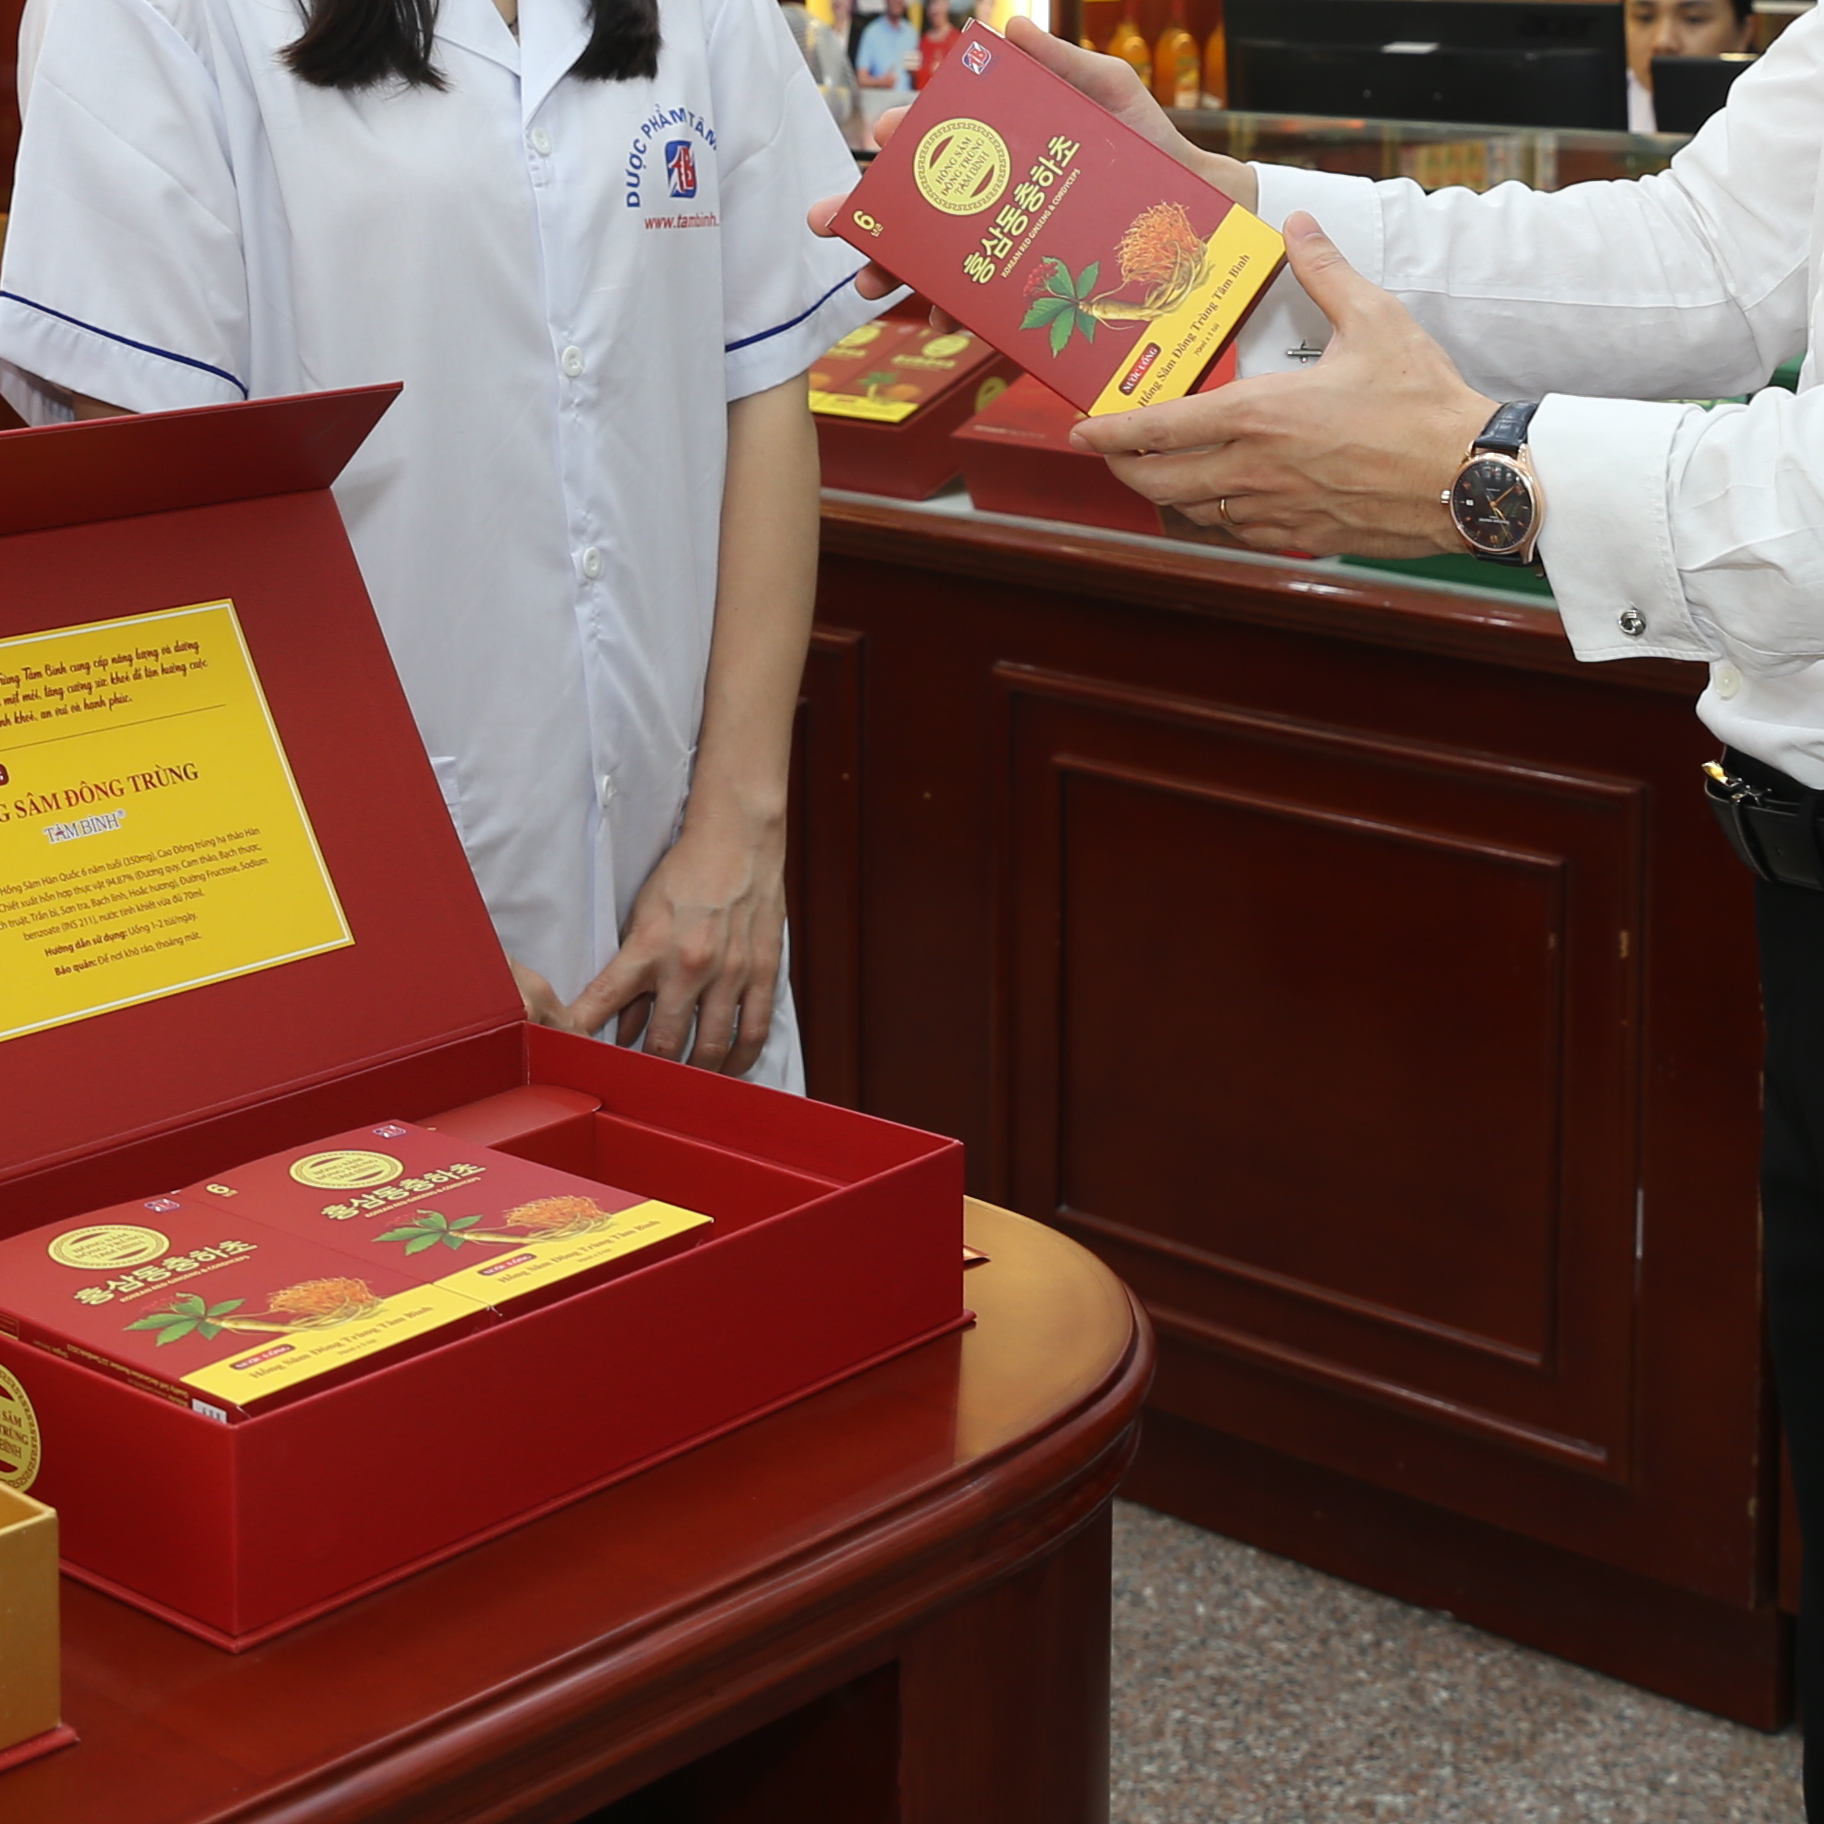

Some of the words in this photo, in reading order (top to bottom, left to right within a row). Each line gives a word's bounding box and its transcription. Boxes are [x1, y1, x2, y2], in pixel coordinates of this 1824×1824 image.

[626, 138, 646, 207] DƯỢC
[640, 103, 687, 139] PHẨM
[688, 110, 717, 151] TÂM
[963, 134, 1081, 284] 홍삼동충하초
[1157, 359, 1177, 381] Sâm
[1191, 303, 1219, 331] Trùng
[1212, 278, 1234, 300] Tâm
[1229, 254, 1251, 278] Bình
[13, 792, 62, 820] SÂM
[63, 780, 126, 809] ĐÔNG
[127, 762, 200, 796] TRÙNG
[42, 822, 81, 845] TÂM
